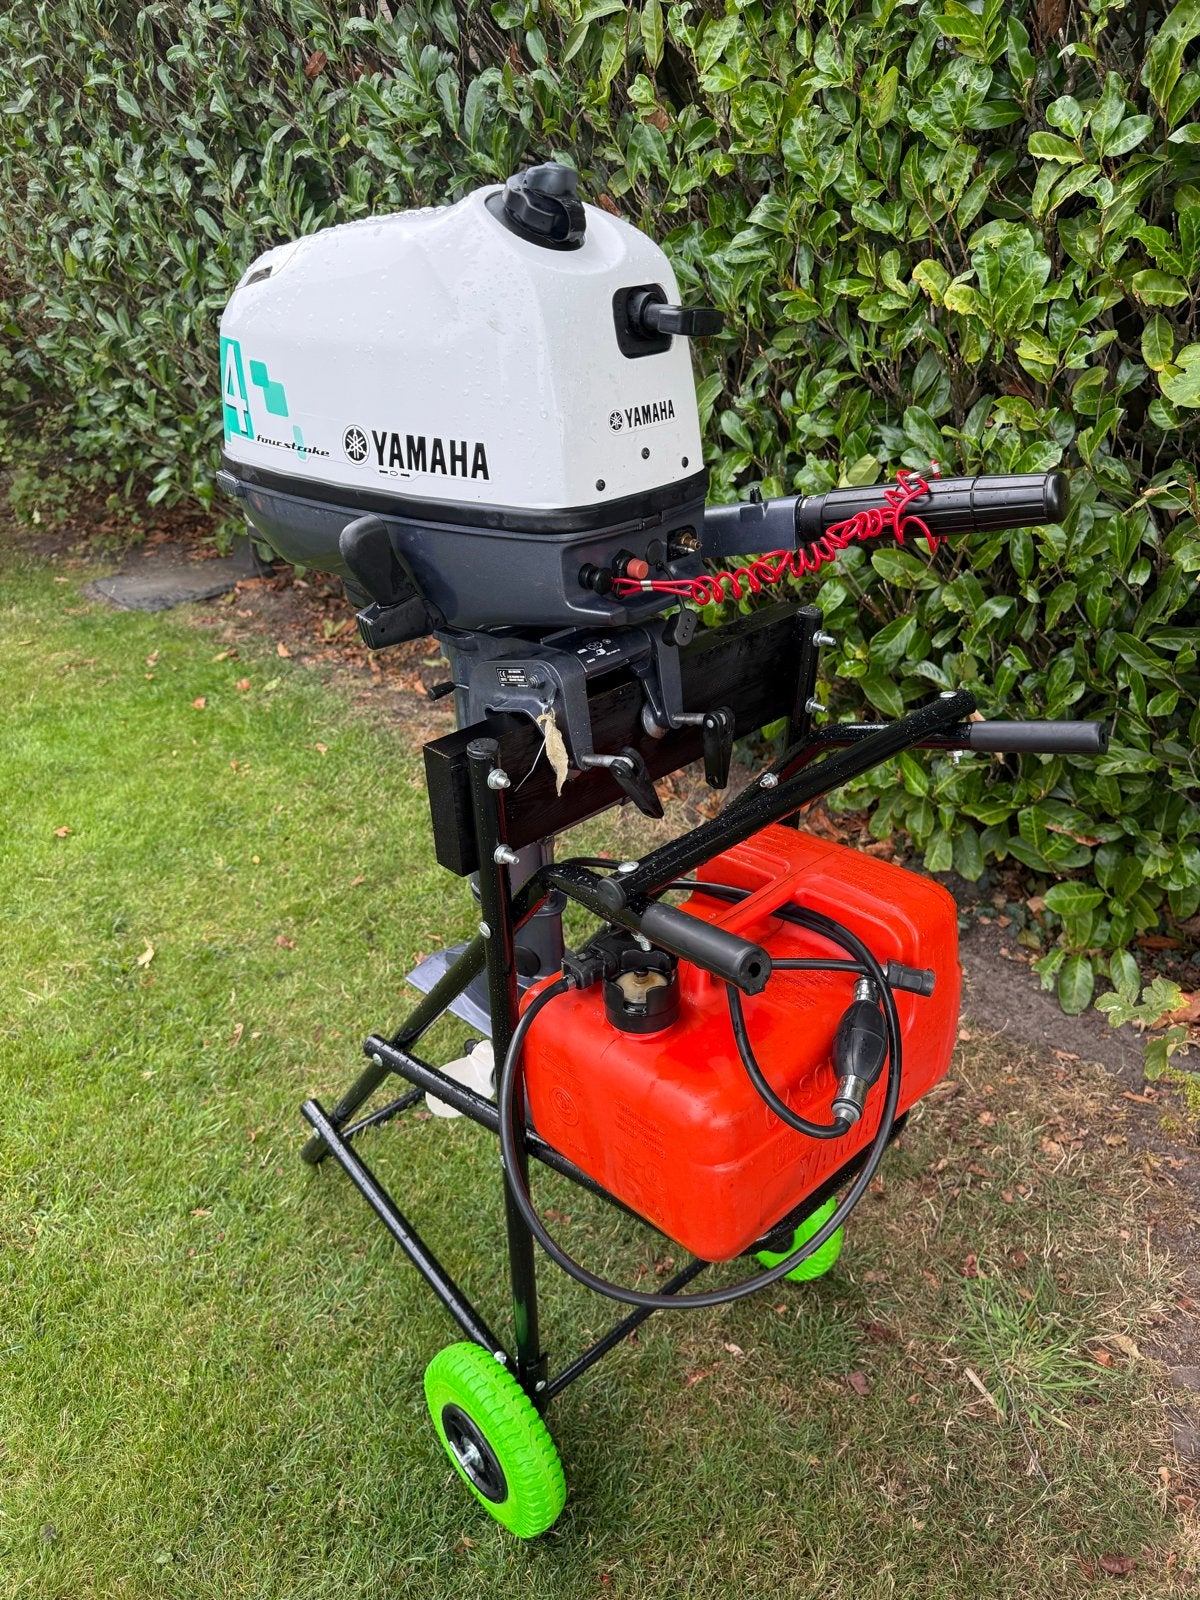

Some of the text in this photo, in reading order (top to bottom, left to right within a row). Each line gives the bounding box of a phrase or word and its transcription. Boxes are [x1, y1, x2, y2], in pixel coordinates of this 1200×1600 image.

[224, 343, 249, 435] 4
[624, 399, 675, 428] YAMAHA
[371, 430, 490, 480] YAMAHA
